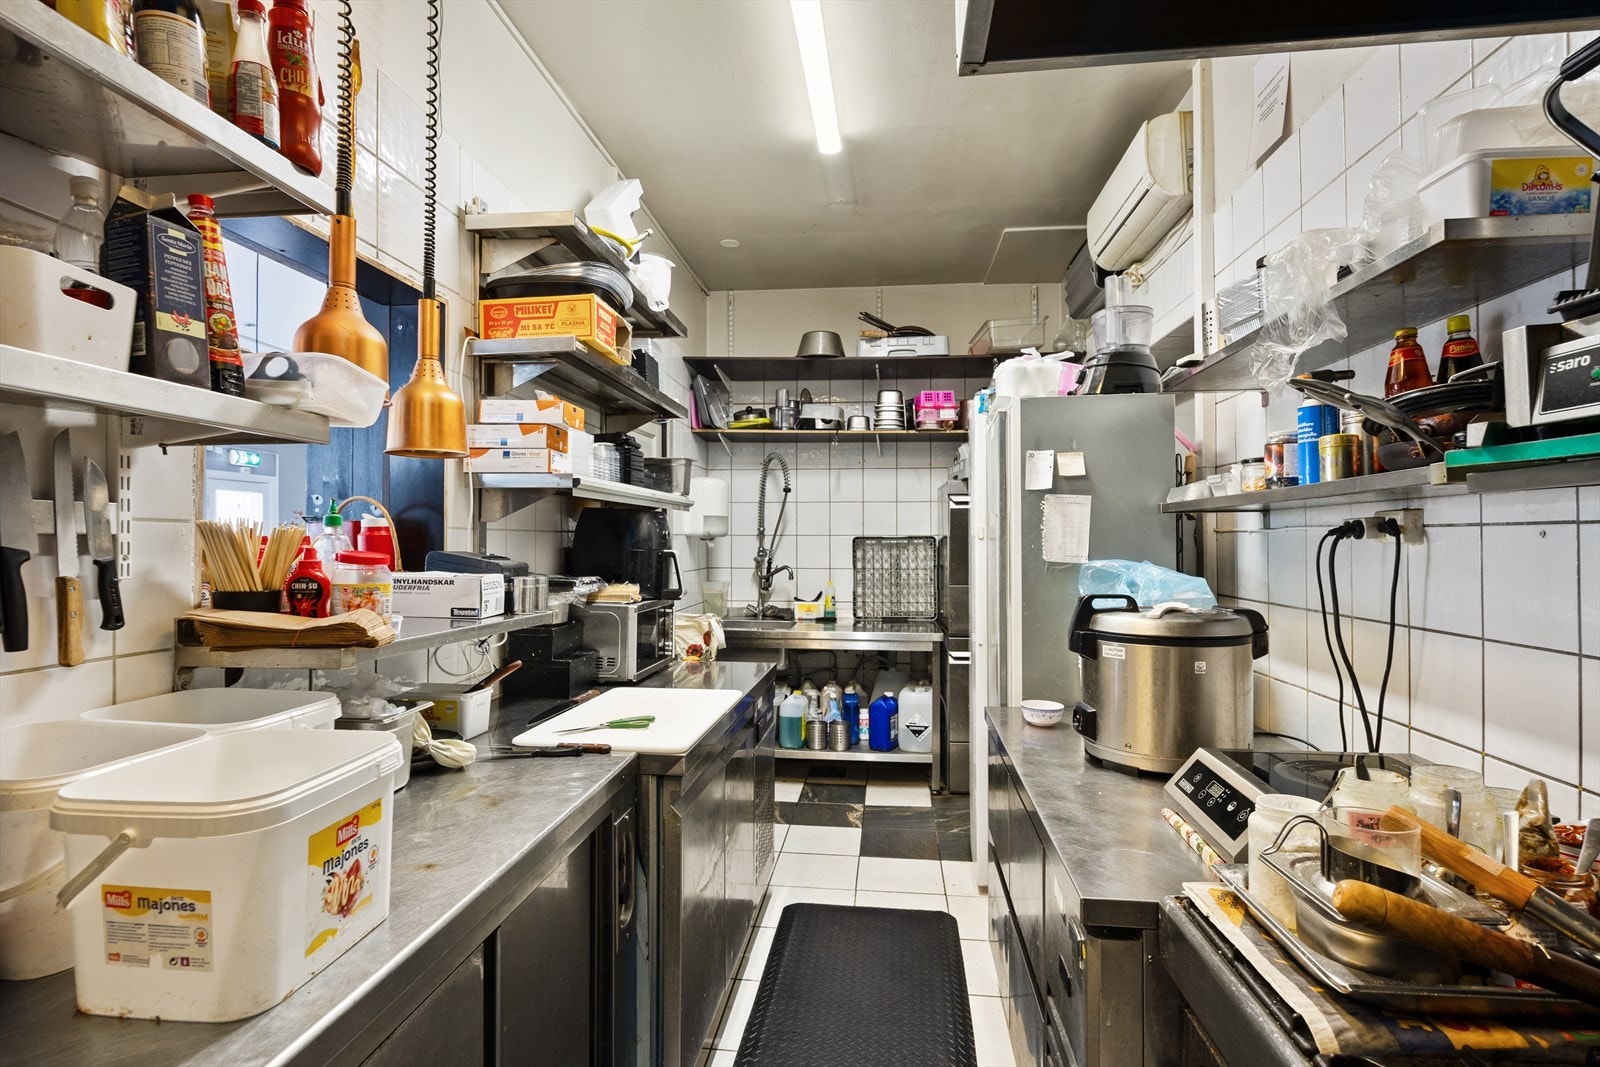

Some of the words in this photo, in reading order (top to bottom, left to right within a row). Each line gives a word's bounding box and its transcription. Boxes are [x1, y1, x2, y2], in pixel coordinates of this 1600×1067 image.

[514, 303, 554, 316] MILIKET
[1556, 355, 1591, 372] saro
[291, 582, 318, 590] CHIN-SU
[453, 607, 479, 616] Tingstad
[338, 823, 358, 844] Mills
[106, 893, 131, 907] Mills
